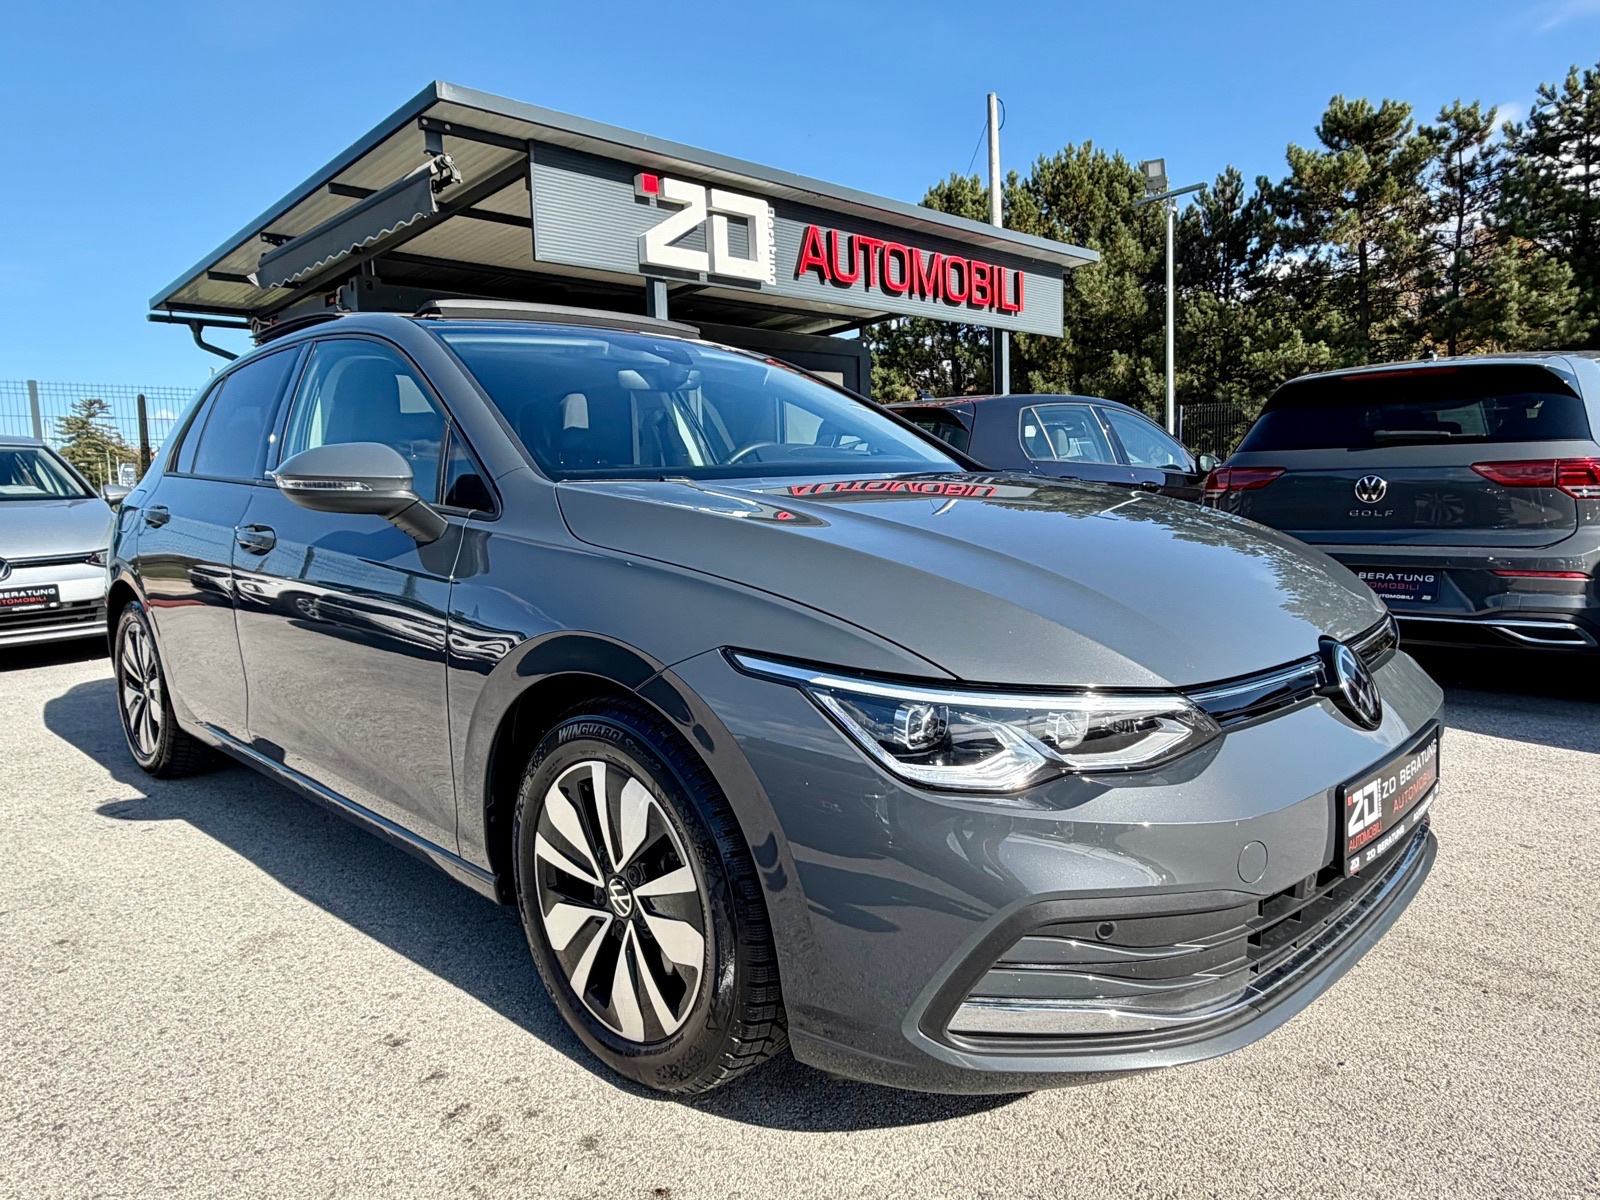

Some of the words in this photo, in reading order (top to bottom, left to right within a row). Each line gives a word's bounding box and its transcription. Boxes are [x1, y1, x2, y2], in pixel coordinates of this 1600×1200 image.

[798, 224, 1025, 312] AUTOMOBILI
[1349, 509, 1394, 517] GOLF
[1358, 572, 1435, 583] BERATUNG
[1367, 581, 1420, 591] OMOBILI
[0, 596, 47, 606] TOMOBILI
[1399, 738, 1438, 786] BERATUNG
